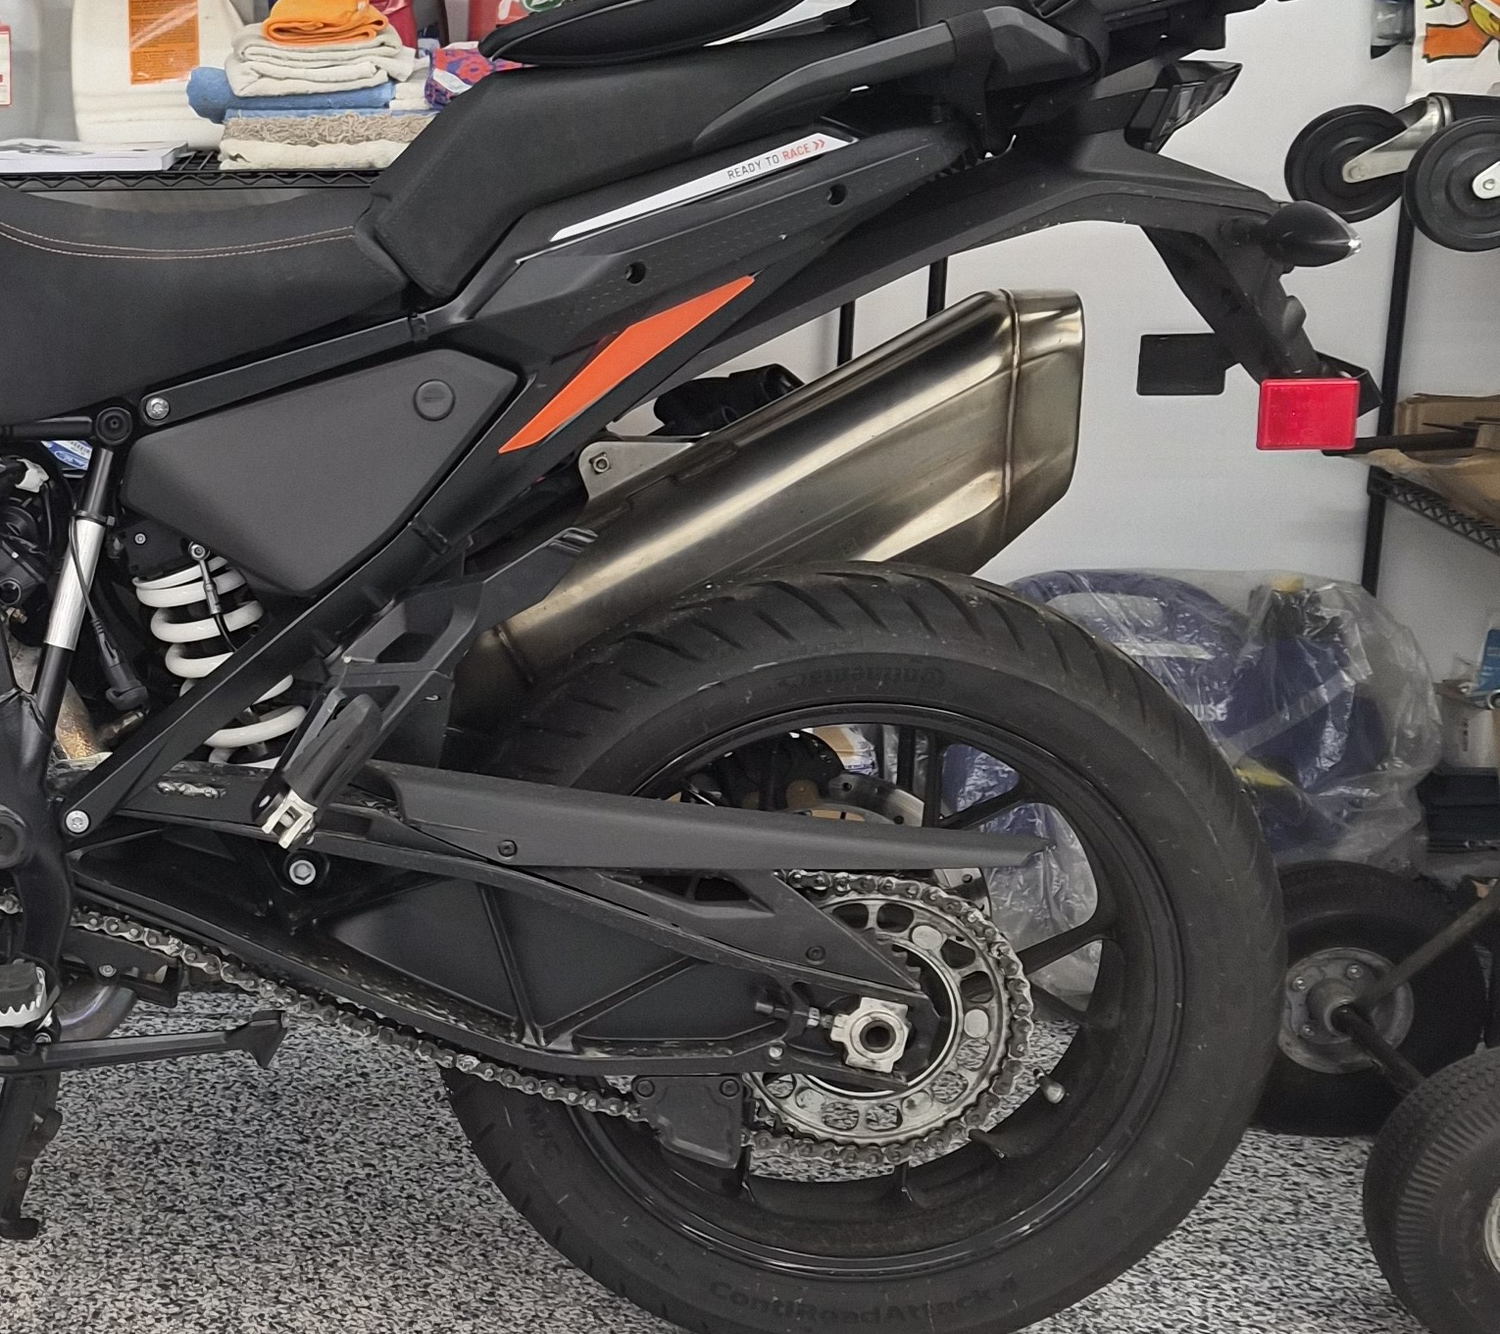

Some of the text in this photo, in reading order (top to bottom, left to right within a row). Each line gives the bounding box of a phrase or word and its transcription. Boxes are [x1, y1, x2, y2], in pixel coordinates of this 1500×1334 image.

[727, 143, 811, 180] READY TO RACE
